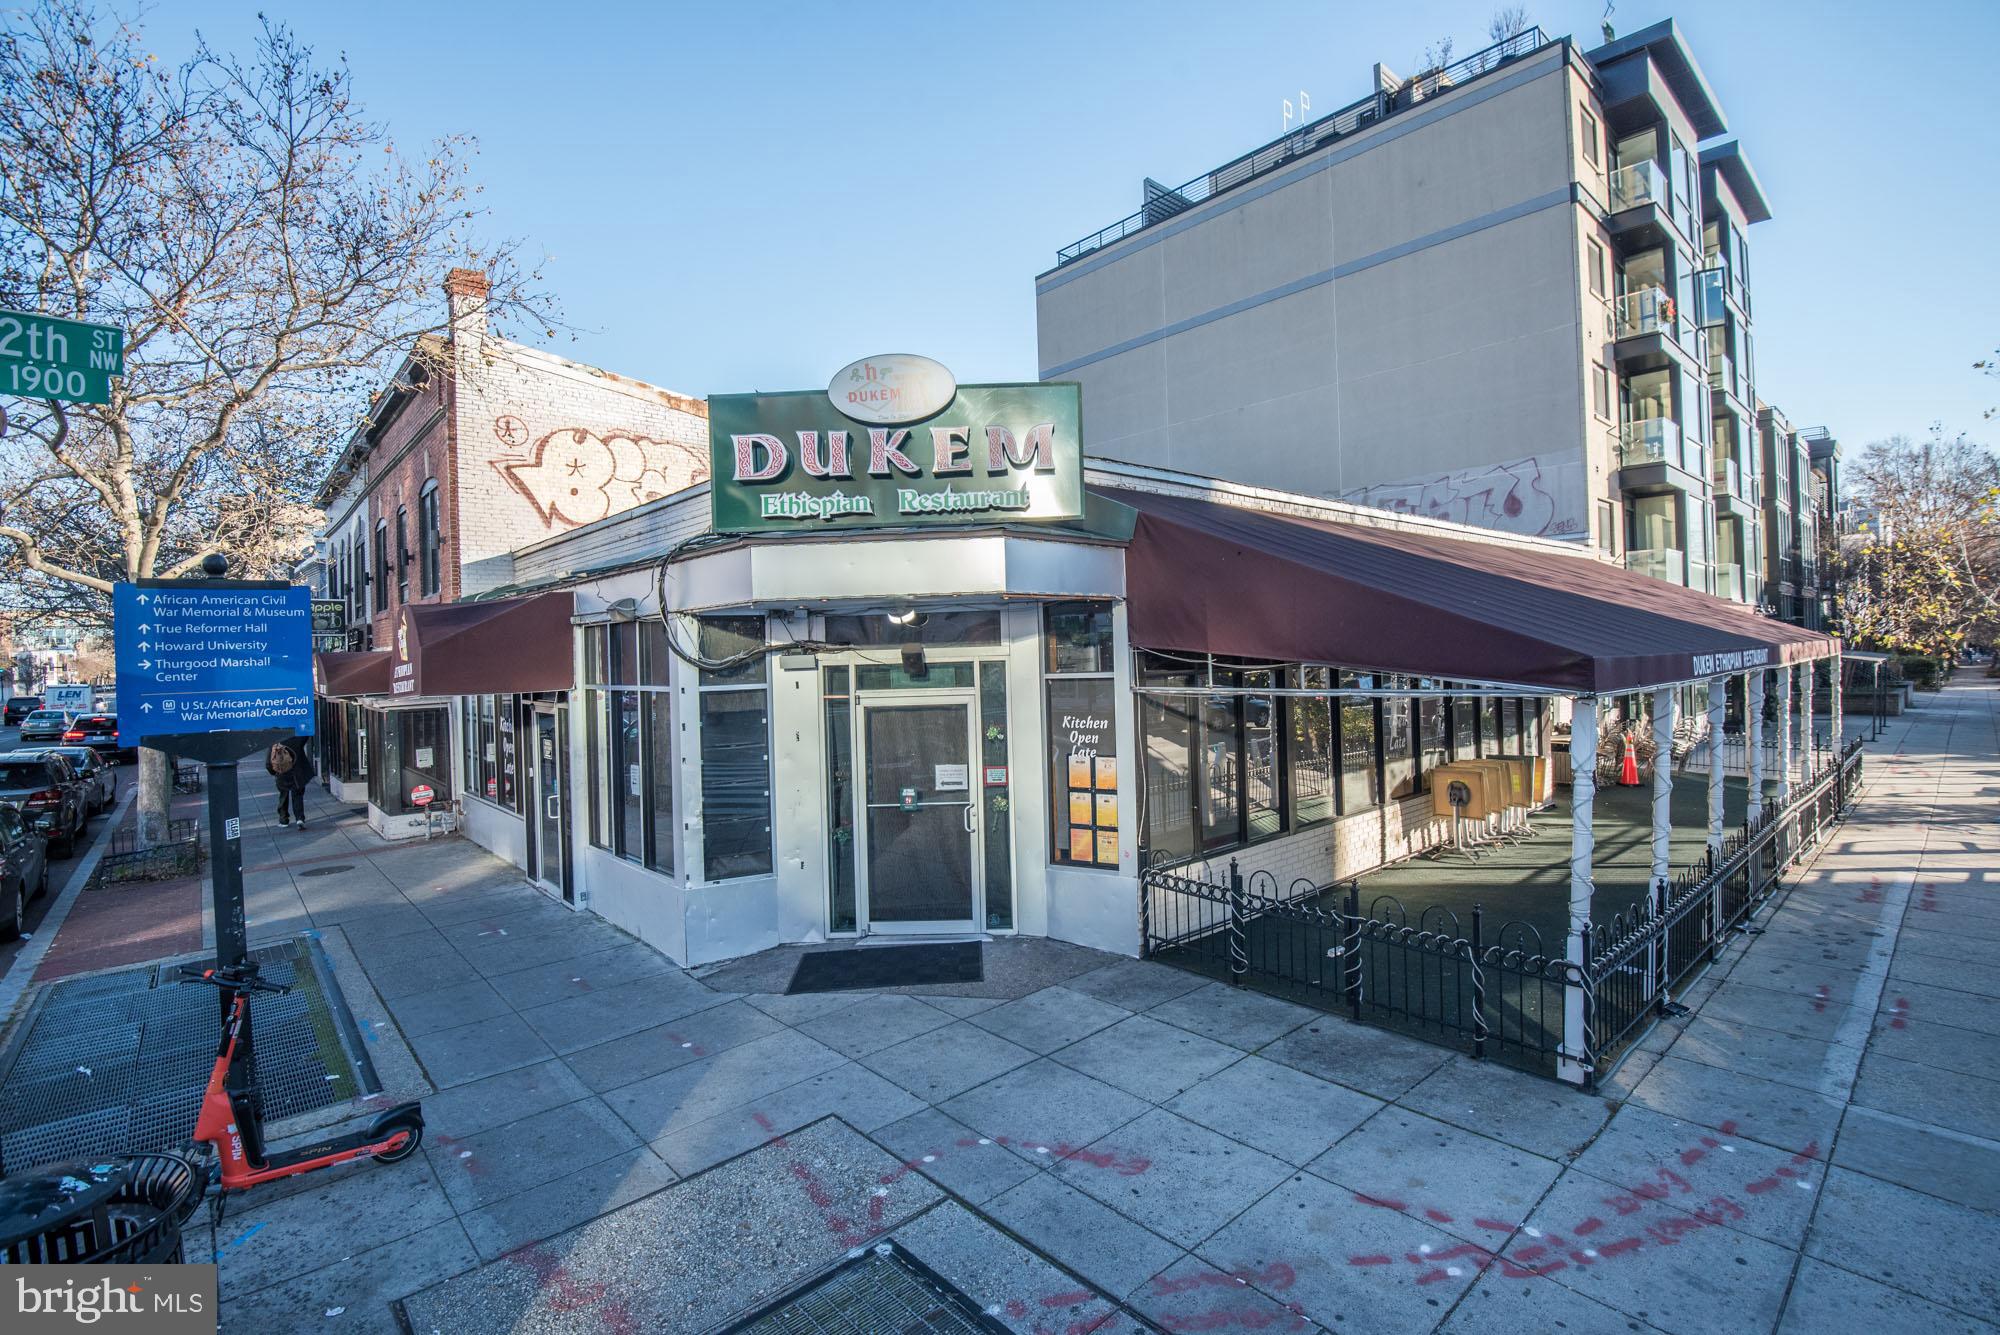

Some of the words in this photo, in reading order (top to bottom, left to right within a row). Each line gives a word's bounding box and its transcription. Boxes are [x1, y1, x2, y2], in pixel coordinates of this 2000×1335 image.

[92, 329, 116, 350] ST
[90, 350, 118, 371] NW
[10, 364, 86, 397] 1900
[847, 387, 901, 404] DUKEM
[730, 423, 1056, 482] DUKEM
[761, 488, 874, 521] Ethiopian
[897, 482, 1030, 514] Restaurant
[153, 594, 197, 605] African
[201, 595, 259, 605] American
[261, 594, 286, 605] Civil
[153, 607, 178, 617] War
[182, 607, 240, 617] Memorial
[243, 607, 252, 617] &
[255, 607, 305, 617] Museum
[154, 624, 182, 634] True
[186, 623, 242, 633] Reformer
[245, 622, 268, 633] Hall
[155, 641, 204, 651] Howard
[208, 640, 268, 652] University
[155, 658, 217, 671] Thurgood
[220, 657, 271, 667] Marshall
[1692, 653, 1715, 676] DUKEM
[1715, 651, 1743, 672] ETHIOPIAN
[155, 672, 198, 682] Center
[57, 690, 83, 699] LEN
[180, 702, 189, 711] U
[287, 696, 309, 706] Civil
[181, 712, 203, 721] War
[206, 707, 308, 720] Memorial/Cardozo
[1062, 715, 1109, 730] Kitchen
[1069, 731, 1099, 747] Open
[1071, 745, 1097, 758] Late
[231, 1135, 243, 1161] SPIN
[300, 1145, 332, 1156] SPIN
